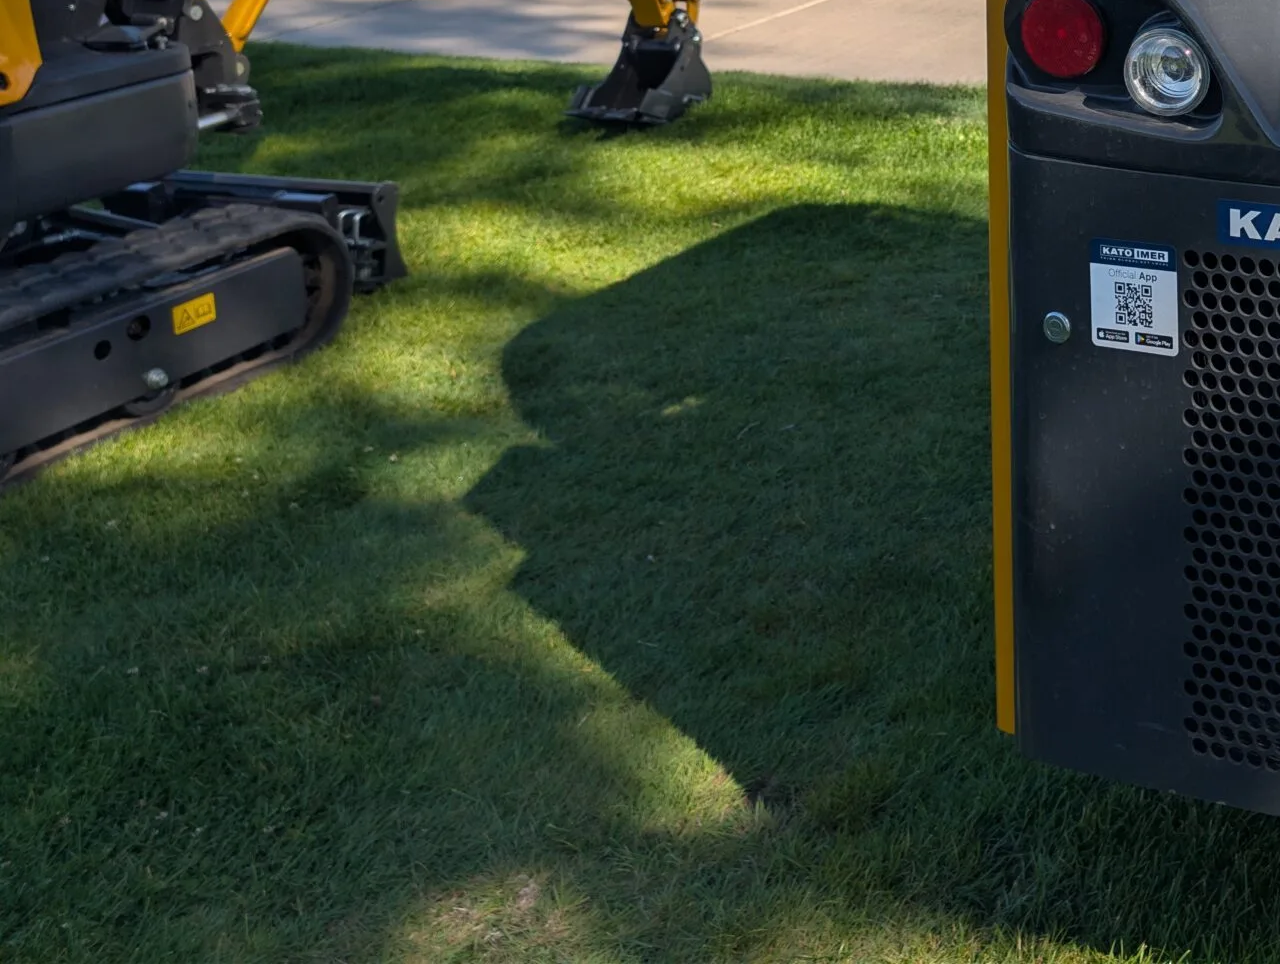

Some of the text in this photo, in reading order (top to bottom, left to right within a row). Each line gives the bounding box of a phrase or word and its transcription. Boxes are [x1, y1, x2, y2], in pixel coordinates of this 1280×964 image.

[1102, 246, 1166, 261] KATO IMER
[1108, 267, 1158, 283] Official App
